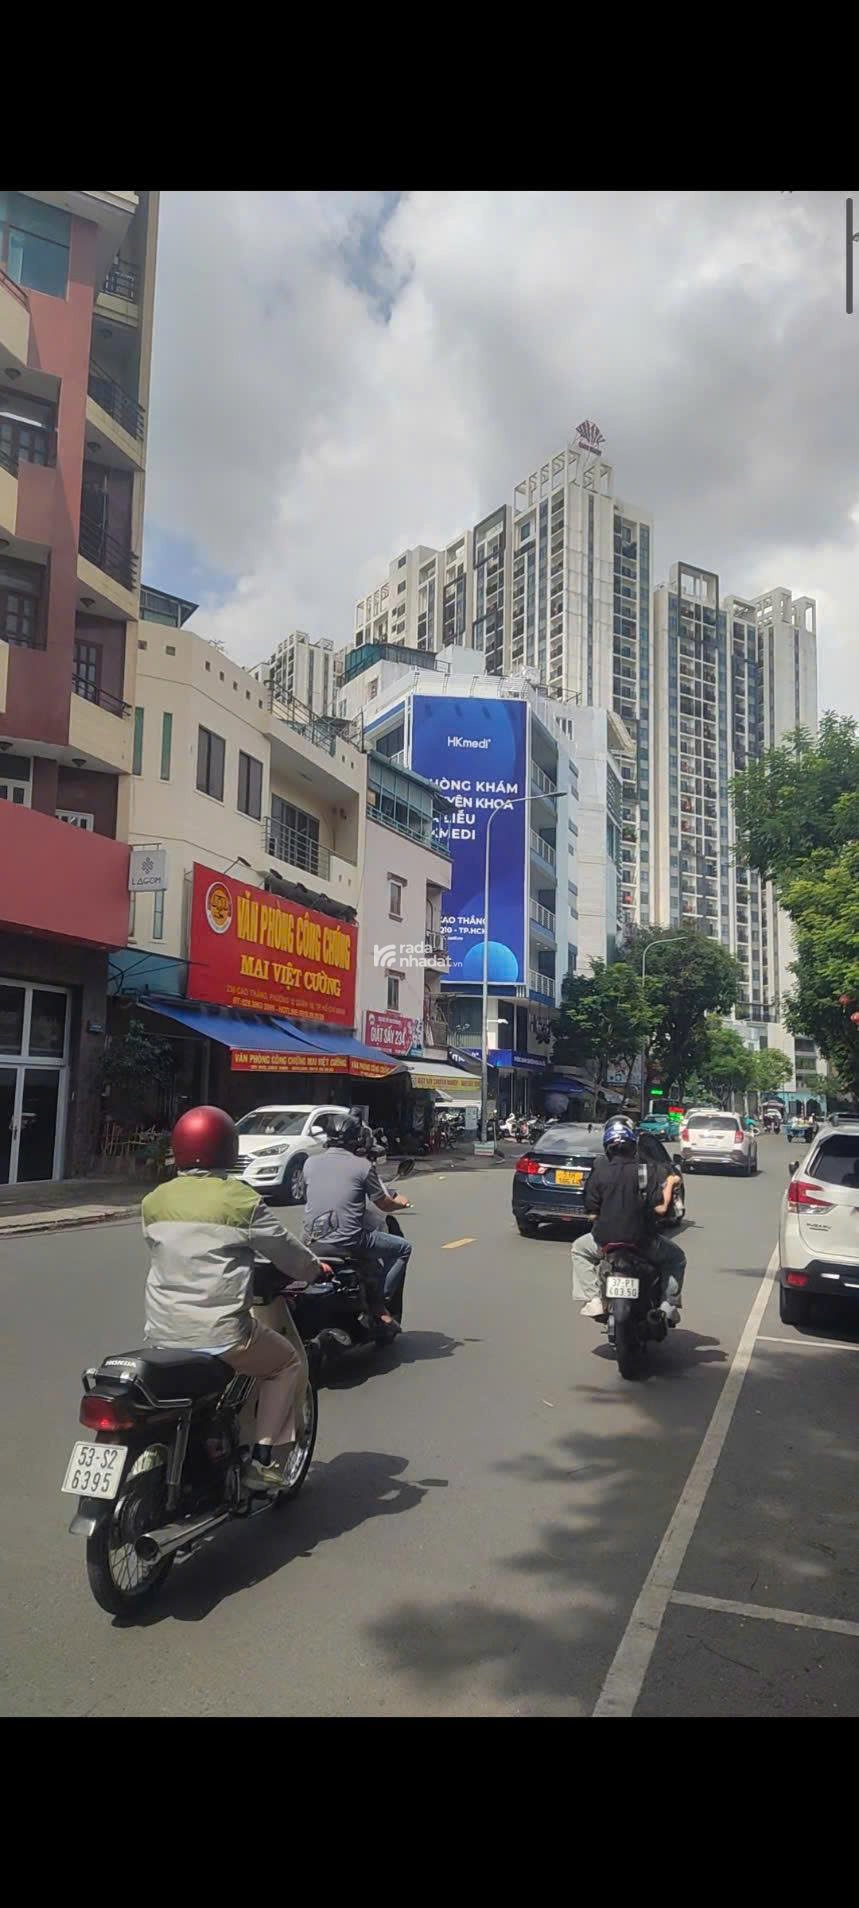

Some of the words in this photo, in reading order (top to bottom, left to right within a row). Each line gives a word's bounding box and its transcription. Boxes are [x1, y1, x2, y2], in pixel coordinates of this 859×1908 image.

[430, 777, 471, 792] HÒNG
[476, 780, 518, 794] KHÁM
[444, 795, 473, 808] YÊN
[475, 798, 514, 810] KHOA
[432, 828, 476, 840] KMEDI
[237, 890, 259, 944] VĂN
[259, 900, 295, 954] PHÒNG
[296, 912, 321, 961] CÔNG
[322, 925, 351, 971] CHỨNG
[240, 954, 269, 980] MAI
[271, 962, 302, 991] VIỆT
[304, 970, 342, 997] CƯỜNG
[370, 1025, 383, 1045] GIẶT
[383, 1025, 394, 1044] SẤY
[234, 1052, 248, 1064] VĂN
[249, 1053, 270, 1065] PHÒNG
[271, 1054, 287, 1065] CÔNG
[78, 1446, 118, 1470] 53-S2
[71, 1470, 111, 1493] 6395
